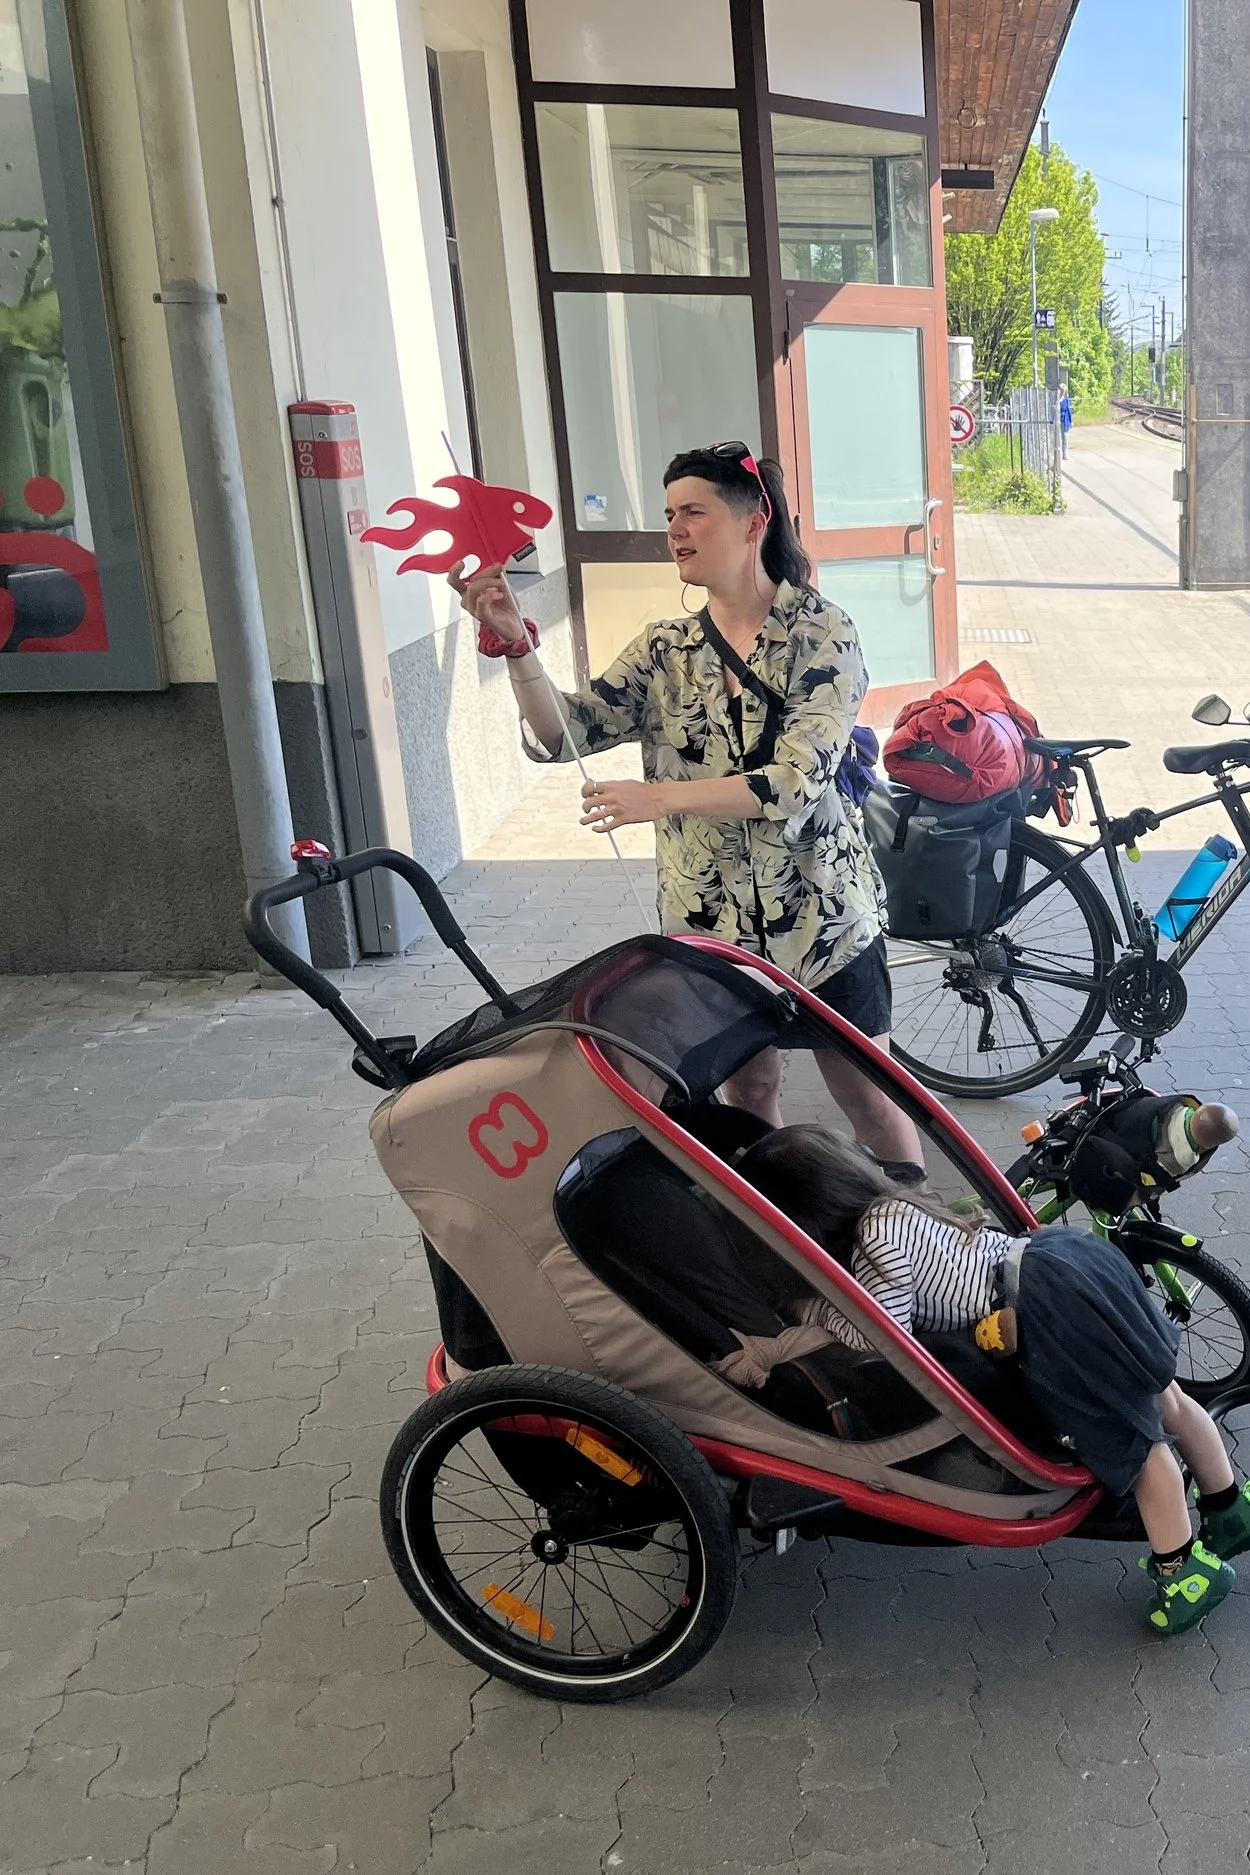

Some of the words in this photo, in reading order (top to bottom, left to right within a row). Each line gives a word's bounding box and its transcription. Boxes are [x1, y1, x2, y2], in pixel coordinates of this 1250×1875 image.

[297, 441, 316, 478] SOS
[341, 446, 362, 473] SOS
[1175, 864, 1242, 962] MERIDA
